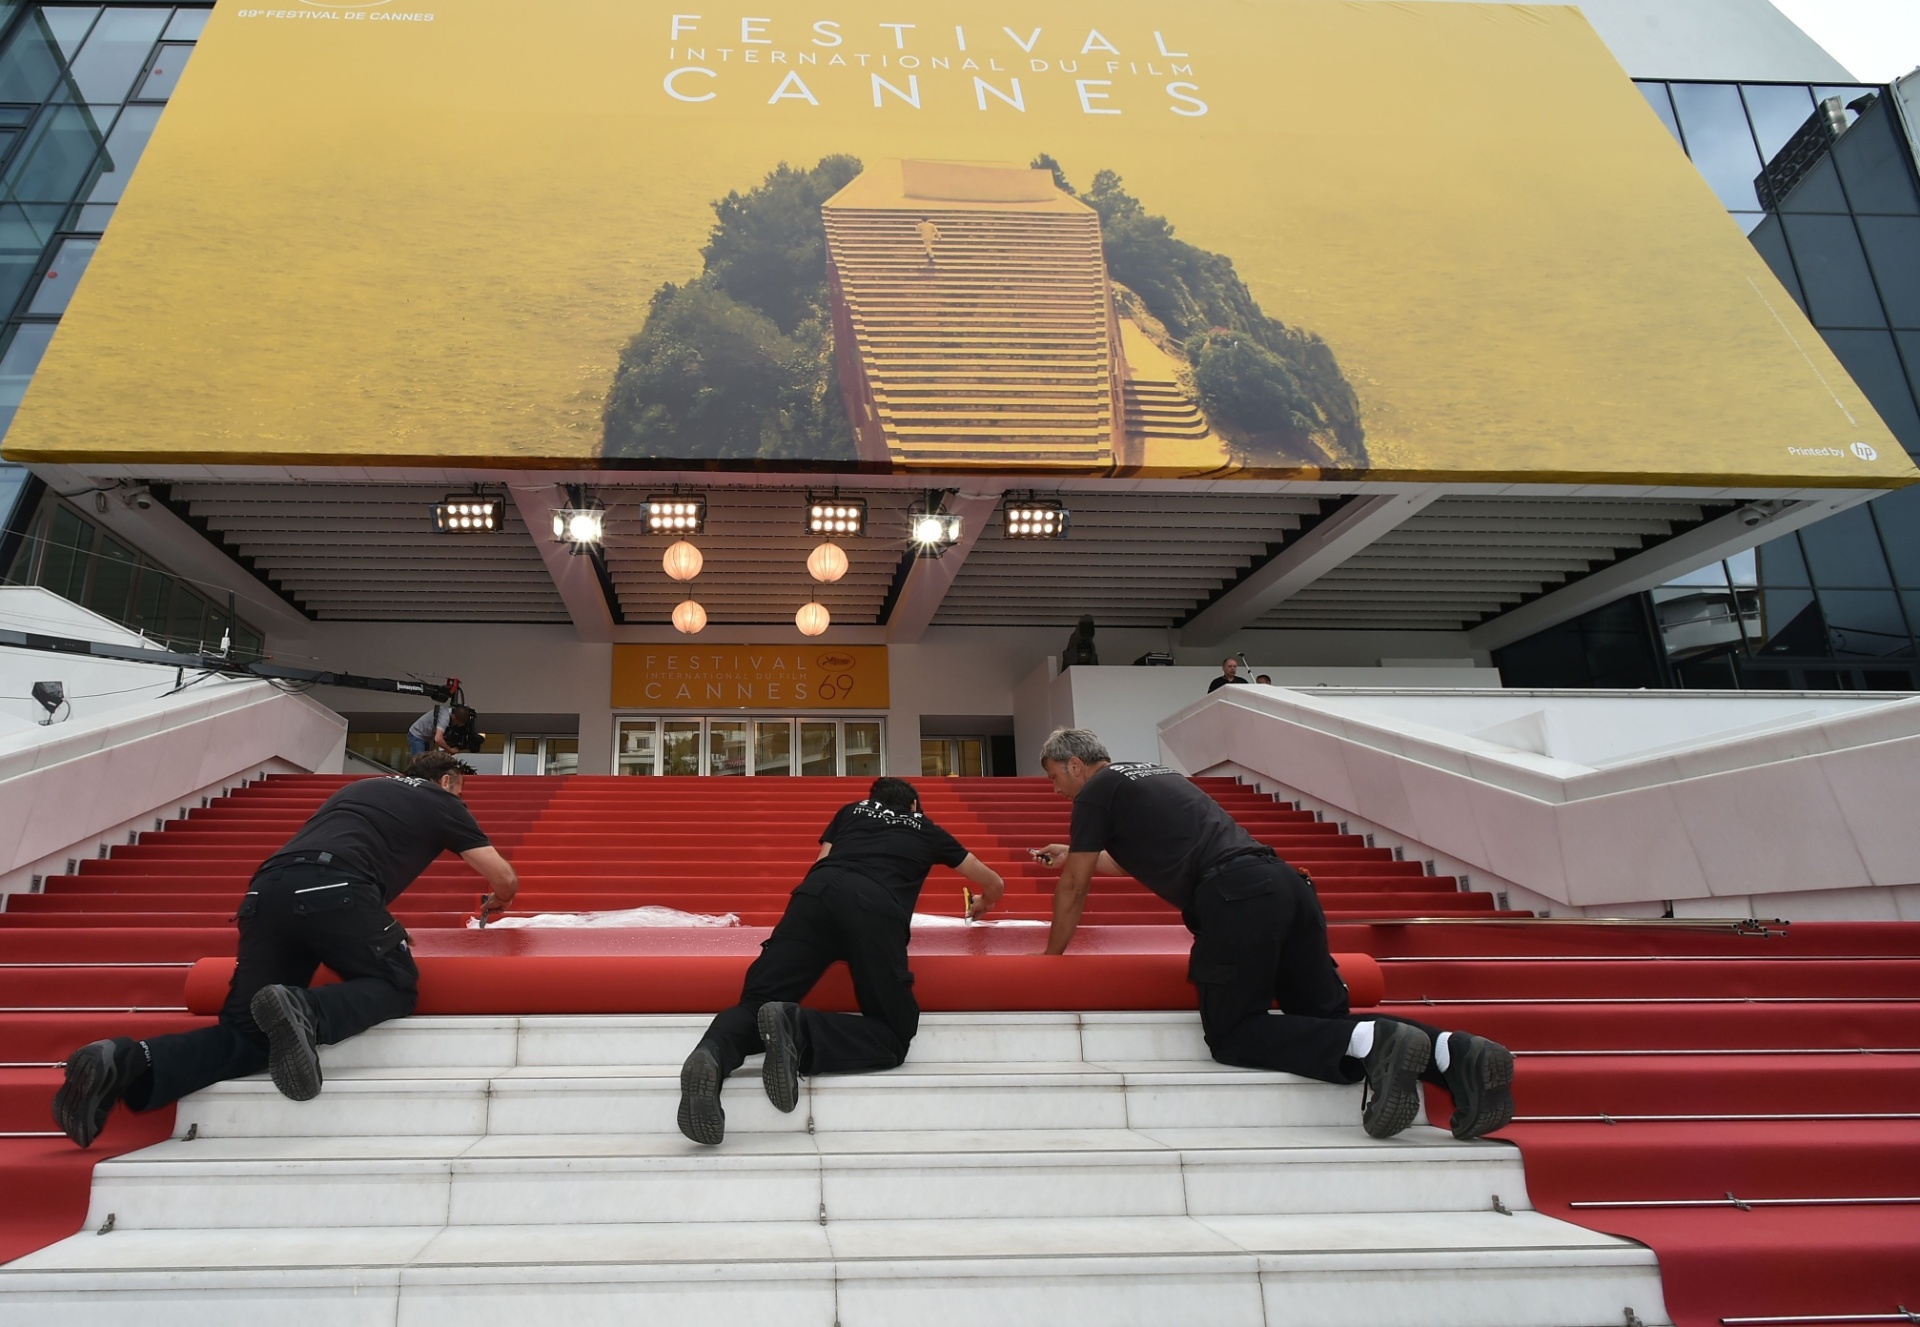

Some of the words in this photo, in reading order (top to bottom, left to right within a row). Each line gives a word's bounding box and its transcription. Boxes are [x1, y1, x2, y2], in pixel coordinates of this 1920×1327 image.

[266, 10, 340, 20] FESTIVAL
[344, 12, 366, 20] DE
[369, 12, 435, 22] CANNES
[671, 14, 1189, 58] FESTIVAL
[670, 47, 1004, 72] INTERNATIONAL
[1030, 59, 1079, 73] DU
[1106, 61, 1194, 76] FILM
[663, 66, 1209, 117] CANNES
[1787, 446, 1829, 456] Printed
[1828, 447, 1845, 458] by
[646, 655, 807, 670] FESTIVAL
[645, 672, 749, 680] INTERNATIONAL
[644, 682, 808, 700] CANNES
[818, 674, 854, 701] 69
